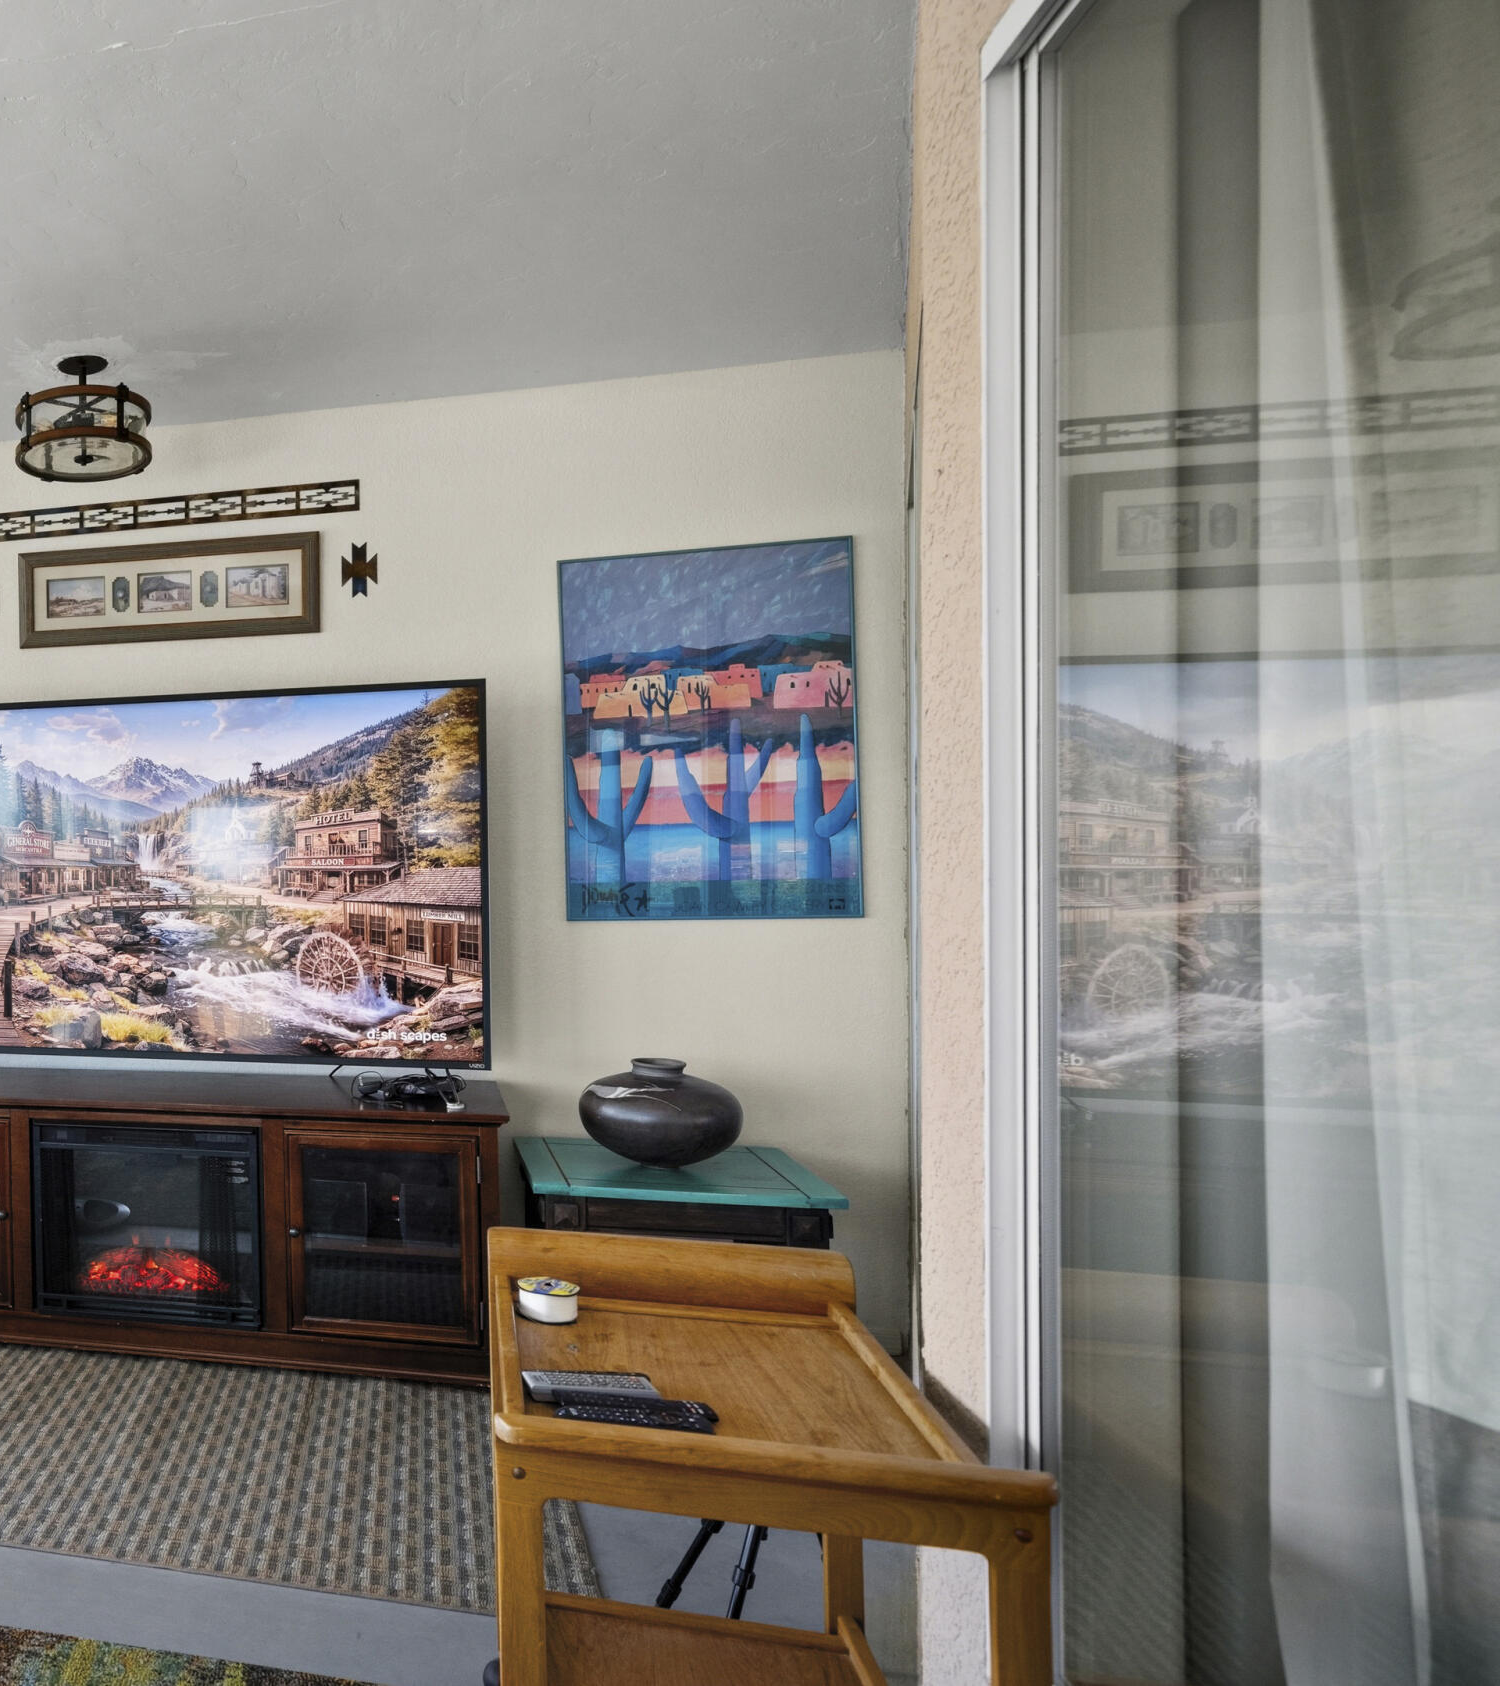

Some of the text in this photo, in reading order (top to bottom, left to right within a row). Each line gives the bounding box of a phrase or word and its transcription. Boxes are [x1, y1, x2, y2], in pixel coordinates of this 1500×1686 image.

[315, 812, 353, 825] HOTEL
[7, 835, 51, 849] GENERAL STORE
[311, 858, 345, 866] SALOON
[366, 1028, 448, 1043] dish scapes
